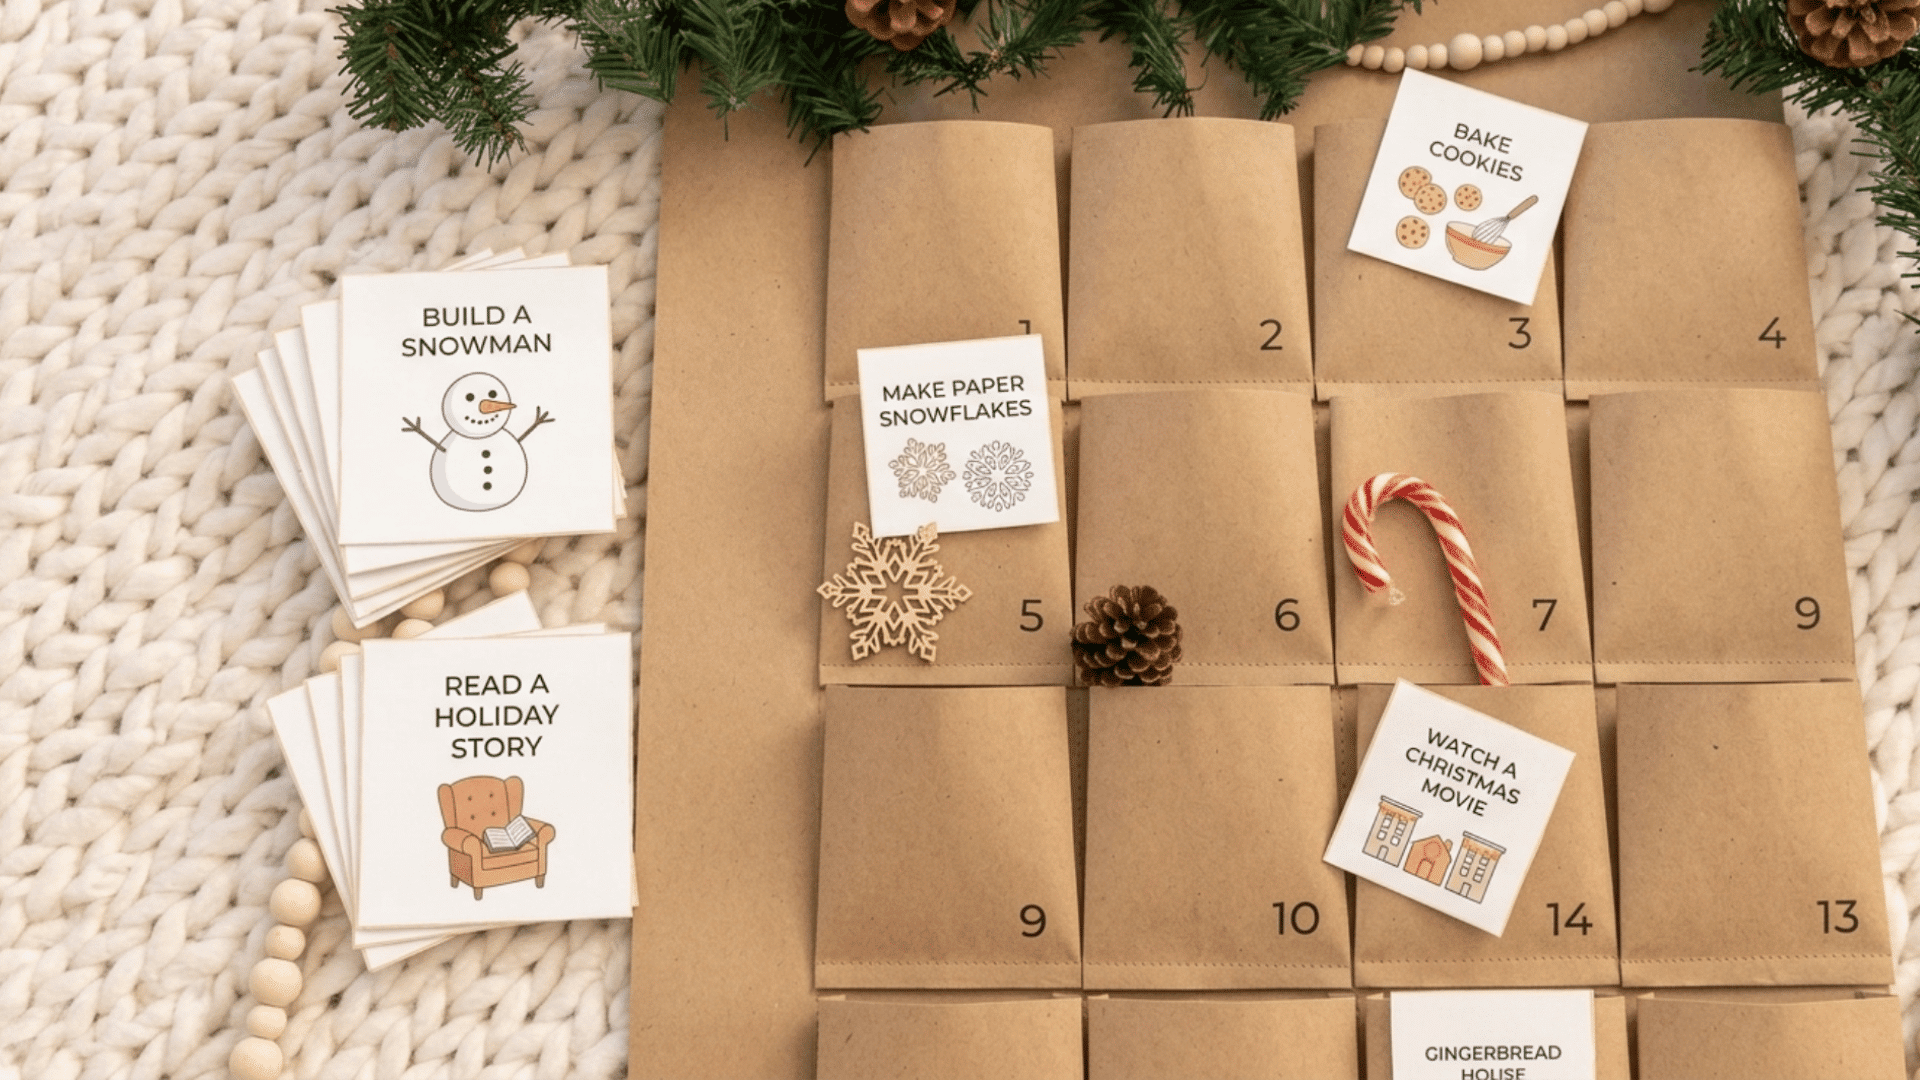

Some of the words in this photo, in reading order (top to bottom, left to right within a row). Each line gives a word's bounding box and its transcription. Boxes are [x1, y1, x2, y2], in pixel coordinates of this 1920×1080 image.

[1453, 122, 1513, 155] BAKE
[1429, 140, 1524, 183] COOKIES
[423, 305, 506, 327] BUILD
[512, 304, 533, 325] A
[402, 333, 552, 357] SNOWMAN
[1259, 319, 1283, 351] 2
[1508, 317, 1532, 350] 3
[1758, 316, 1787, 350] 4
[882, 381, 946, 402] MAKE
[952, 375, 1025, 398] PAPER
[879, 399, 1033, 427] SNOWFLAKES
[1019, 599, 1044, 633] 5
[1274, 598, 1300, 632] 6
[1532, 599, 1558, 632] 7
[1795, 596, 1821, 630] 9
[445, 674, 523, 696] READ
[529, 673, 551, 694] A
[435, 704, 560, 728] HOLIDAY
[451, 735, 543, 759] STORY
[1426, 727, 1500, 771] WATCH
[1502, 761, 1517, 780] A
[1405, 746, 1521, 805] CHRISTMAS
[1421, 777, 1488, 817] MOVIE
[1019, 904, 1046, 938] 9
[1272, 901, 1320, 936] 10
[1546, 902, 1593, 936] 14
[1816, 899, 1859, 934] 13
[1425, 1045, 1562, 1062] GINGERBREAD
[1461, 1067, 1526, 1080] HOUSE
